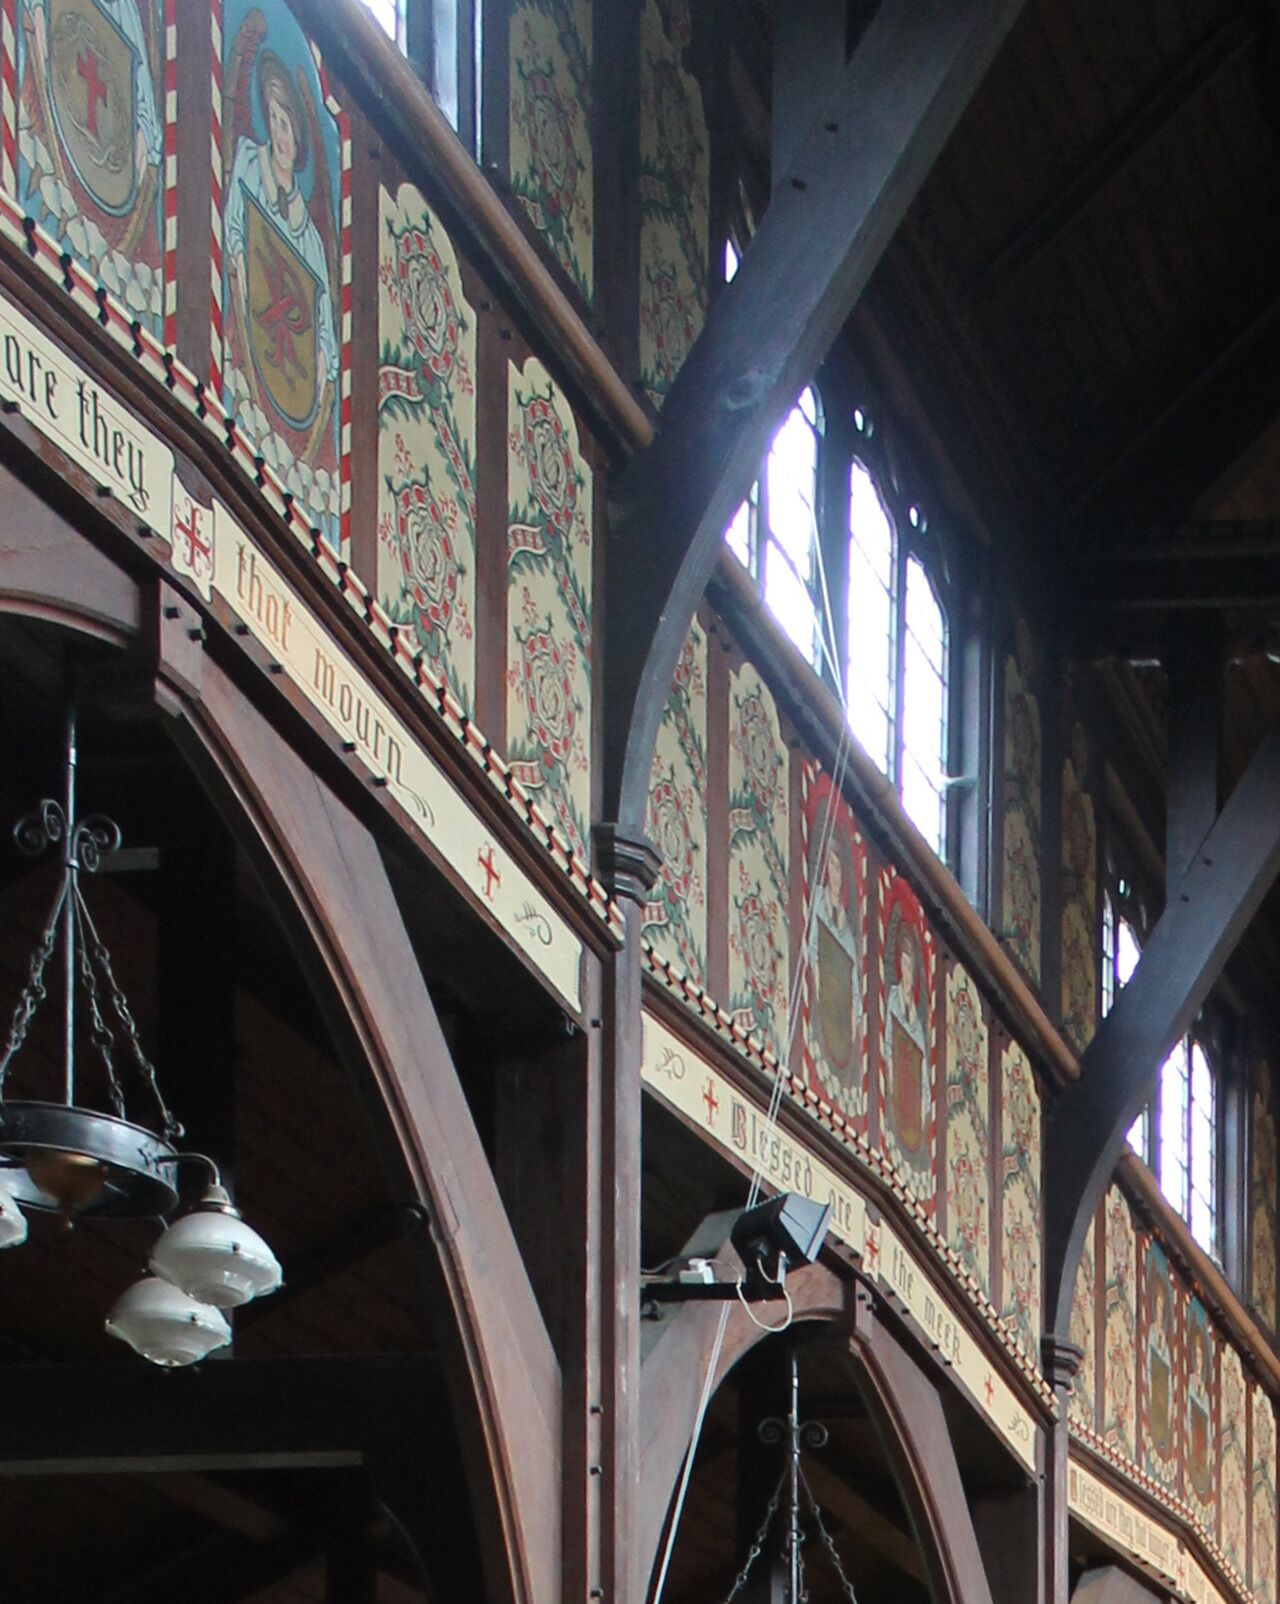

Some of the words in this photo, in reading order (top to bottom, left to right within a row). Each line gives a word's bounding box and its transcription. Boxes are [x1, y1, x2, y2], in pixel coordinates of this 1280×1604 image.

[5, 335, 59, 419] are
[76, 377, 150, 513] they
[236, 540, 293, 652] that
[314, 648, 412, 796] mourn
[731, 1096, 814, 1198] Blessed
[829, 1189, 853, 1233] are
